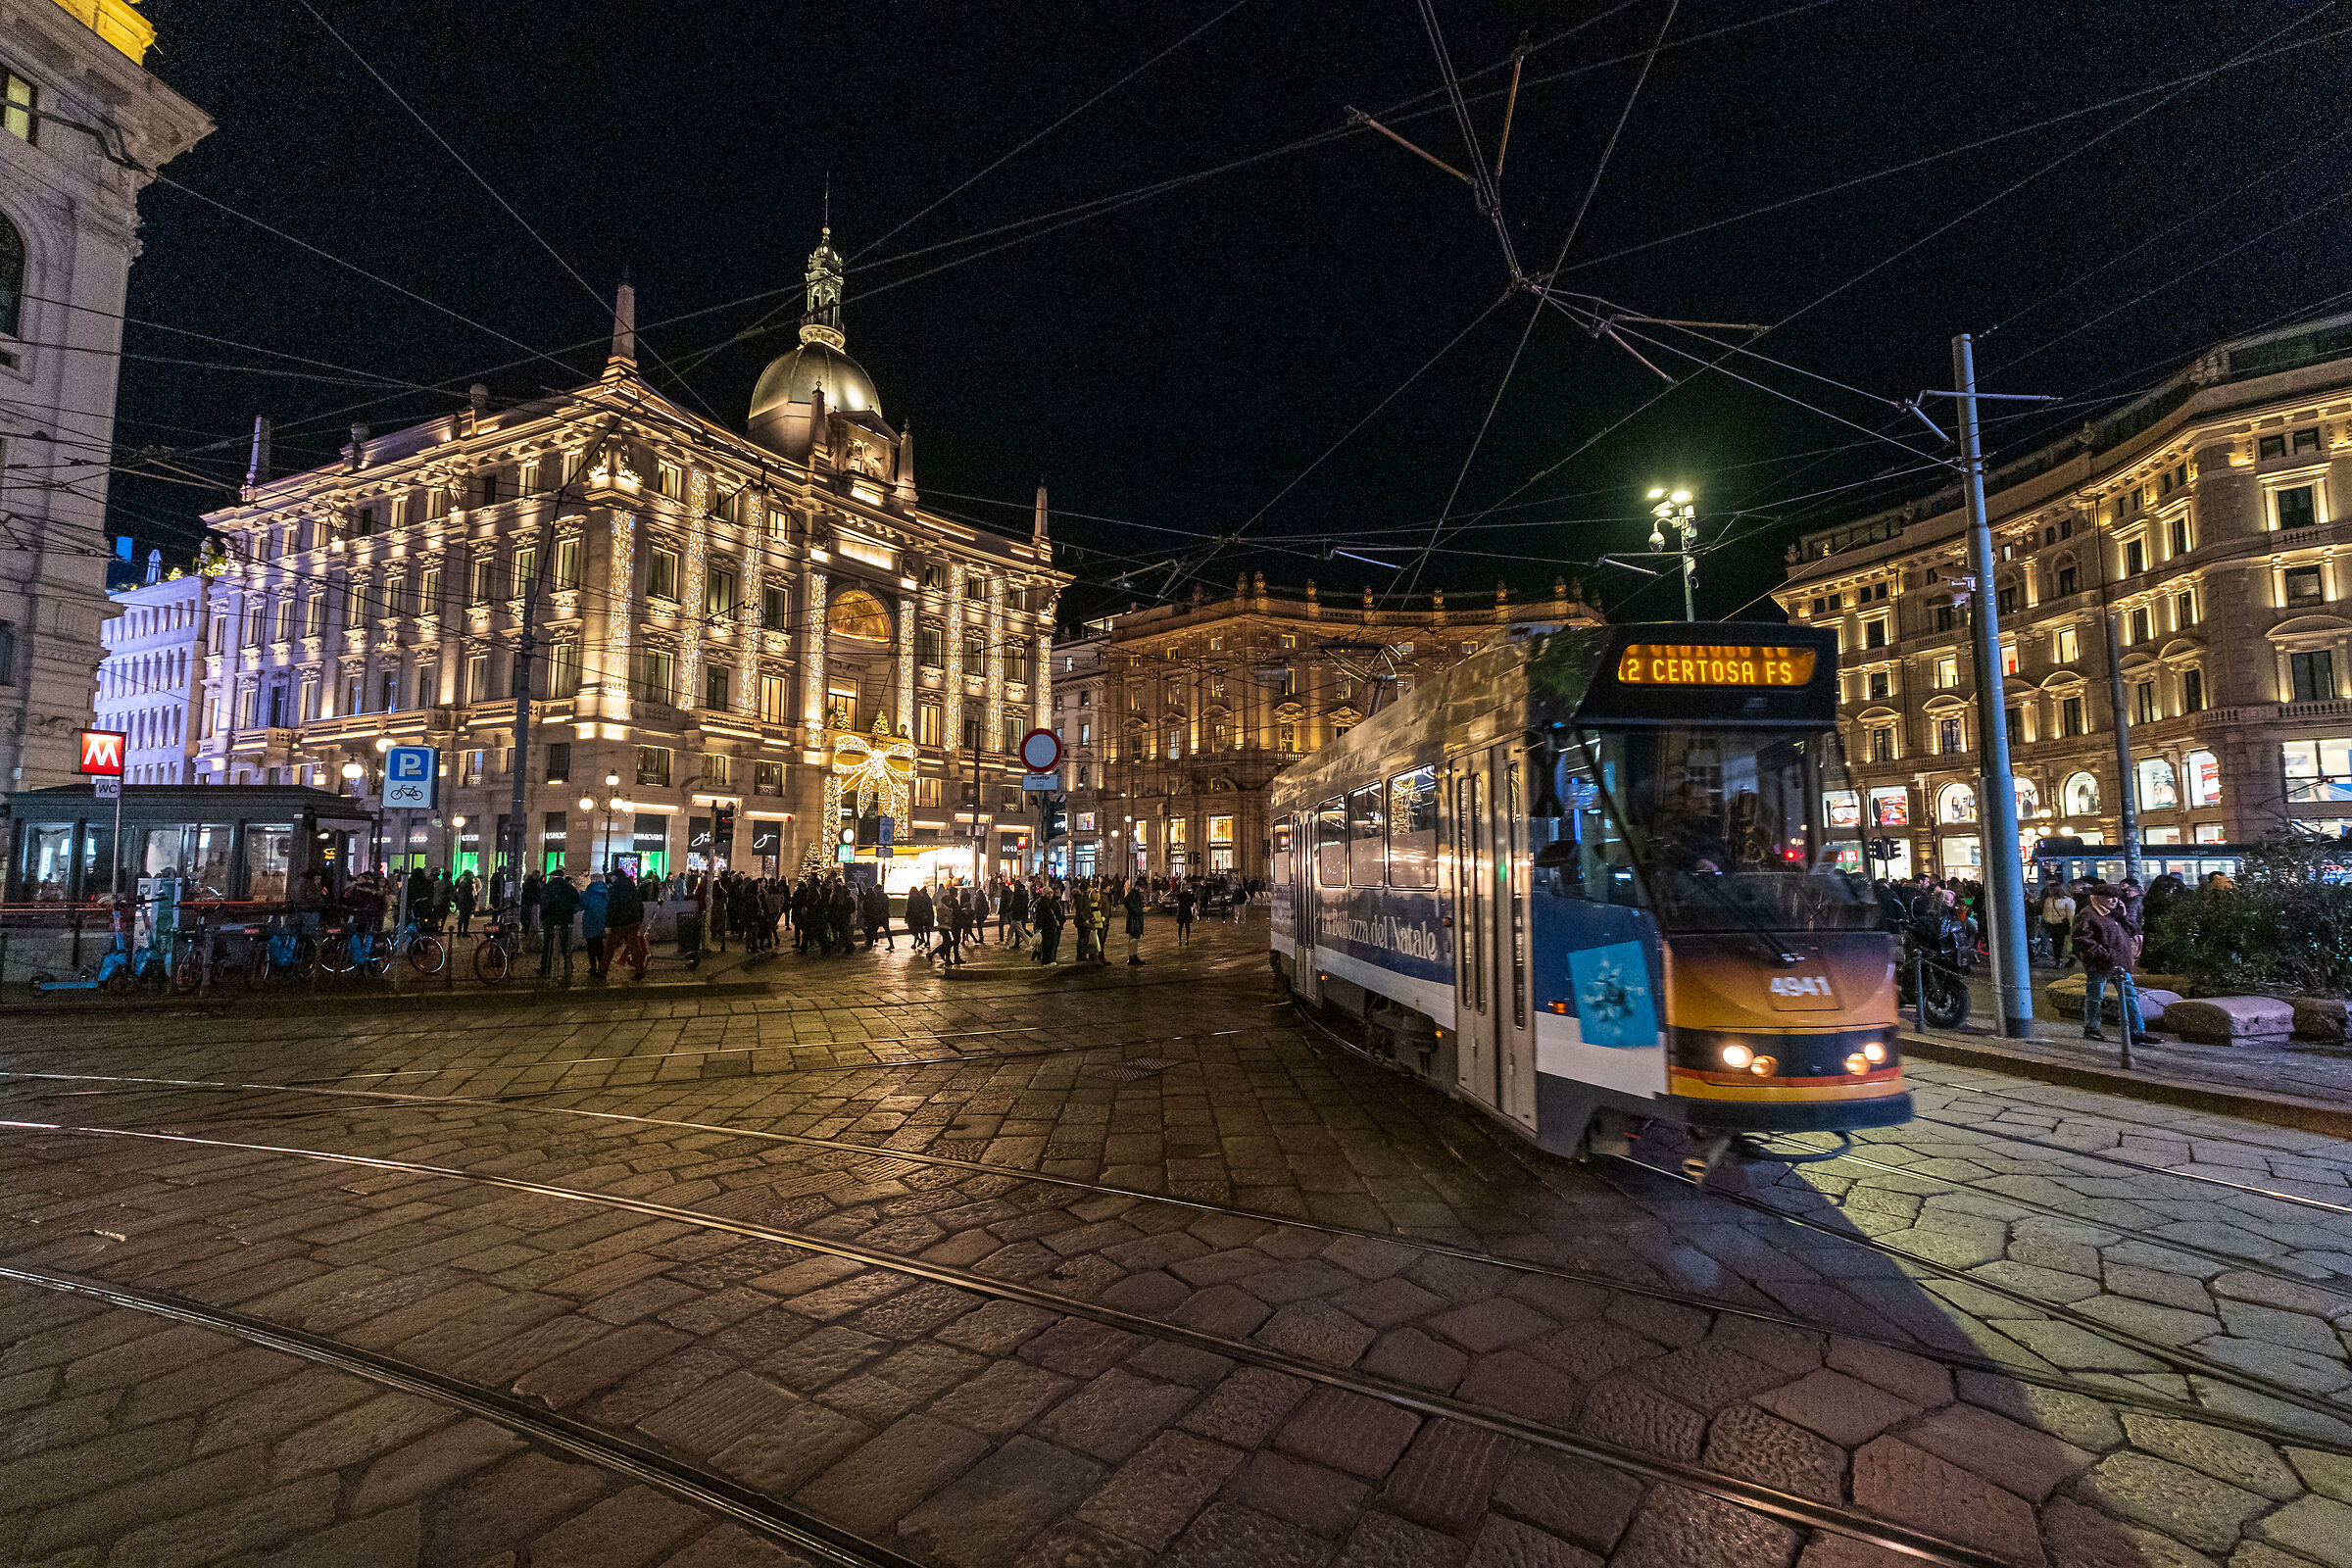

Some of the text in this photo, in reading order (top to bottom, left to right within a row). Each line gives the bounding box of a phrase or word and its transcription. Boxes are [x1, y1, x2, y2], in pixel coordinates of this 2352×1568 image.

[1652, 659, 1754, 683] CERTOSA
[1766, 662, 1792, 684] FS
[82, 737, 120, 767] M
[398, 753, 421, 777] P
[98, 784, 118, 794] WC
[1332, 907, 1370, 945] Bellezza
[1371, 914, 1390, 950] del
[1391, 915, 1438, 961] Natale
[1770, 976, 1832, 997] 4941
